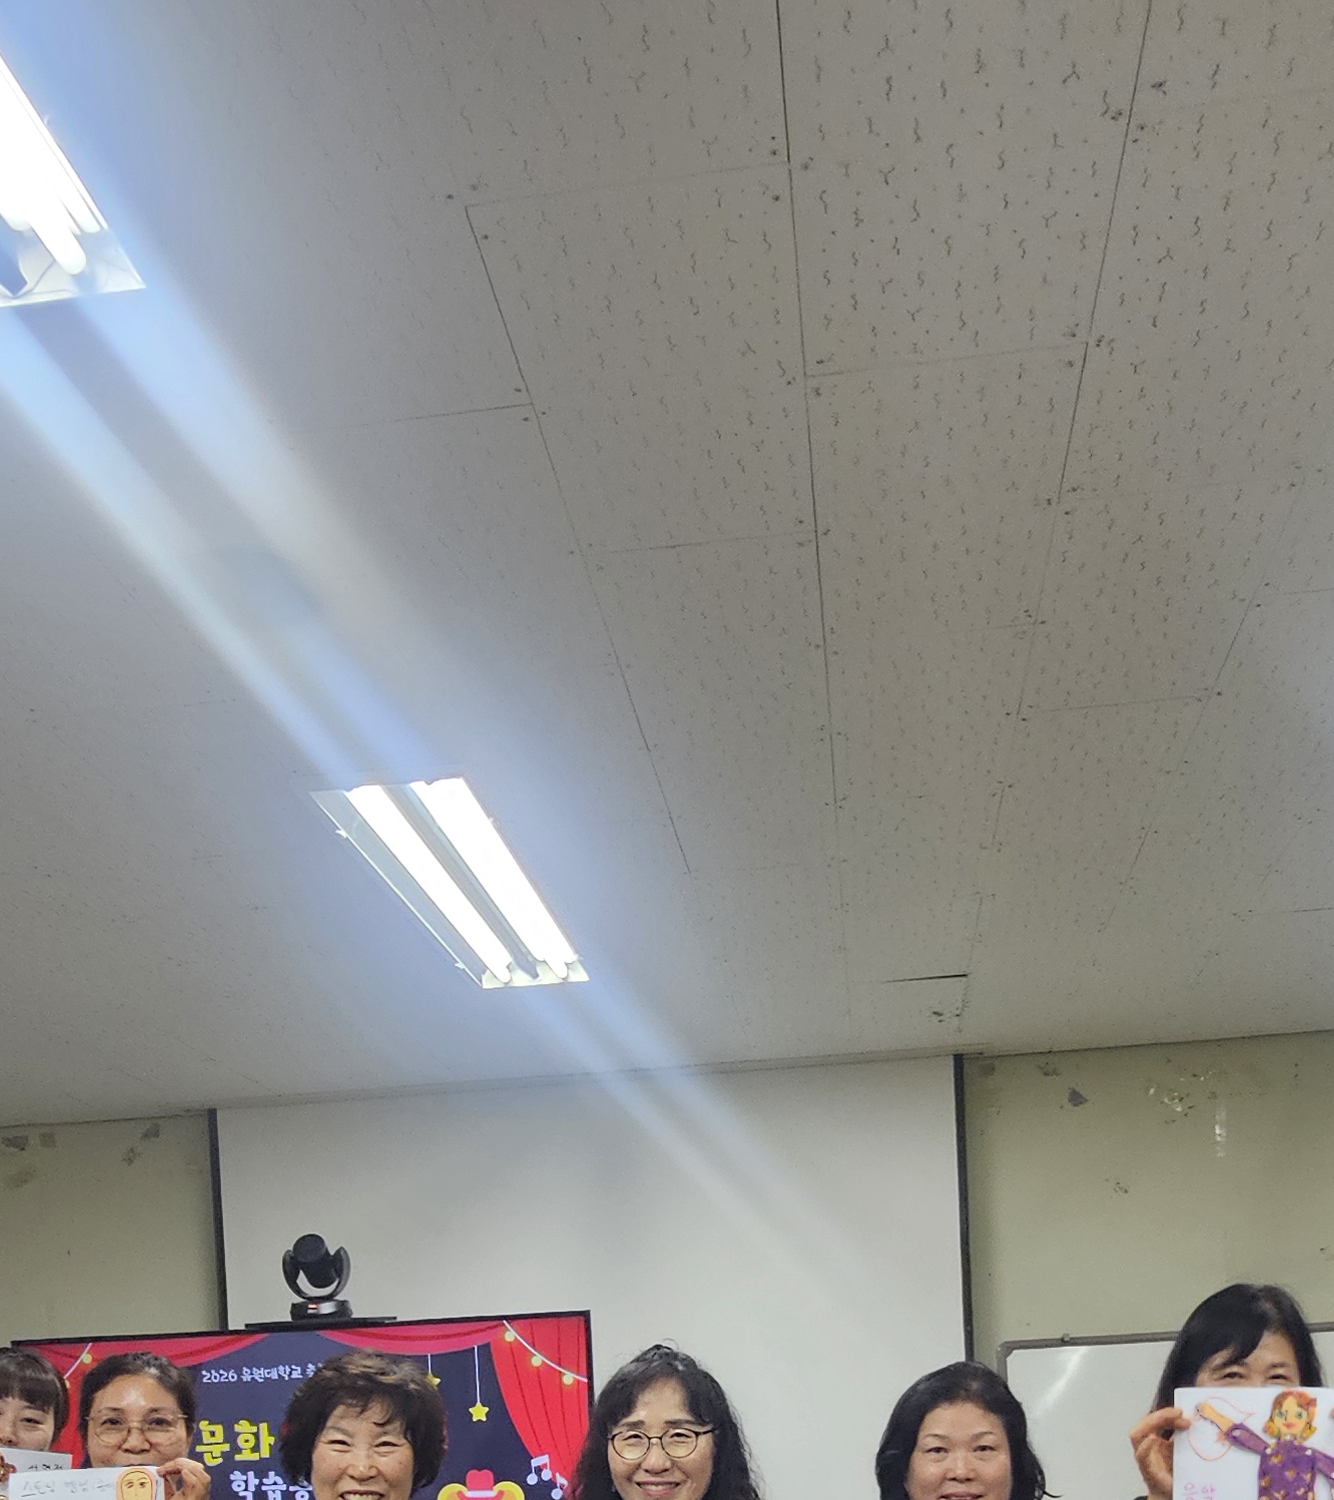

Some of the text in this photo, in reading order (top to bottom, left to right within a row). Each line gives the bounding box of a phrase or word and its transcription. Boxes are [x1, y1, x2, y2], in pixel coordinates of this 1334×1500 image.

[202, 1369, 237, 1383] 2026
[241, 1364, 303, 1382] 유원대학교
[195, 1419, 276, 1467] 문화
